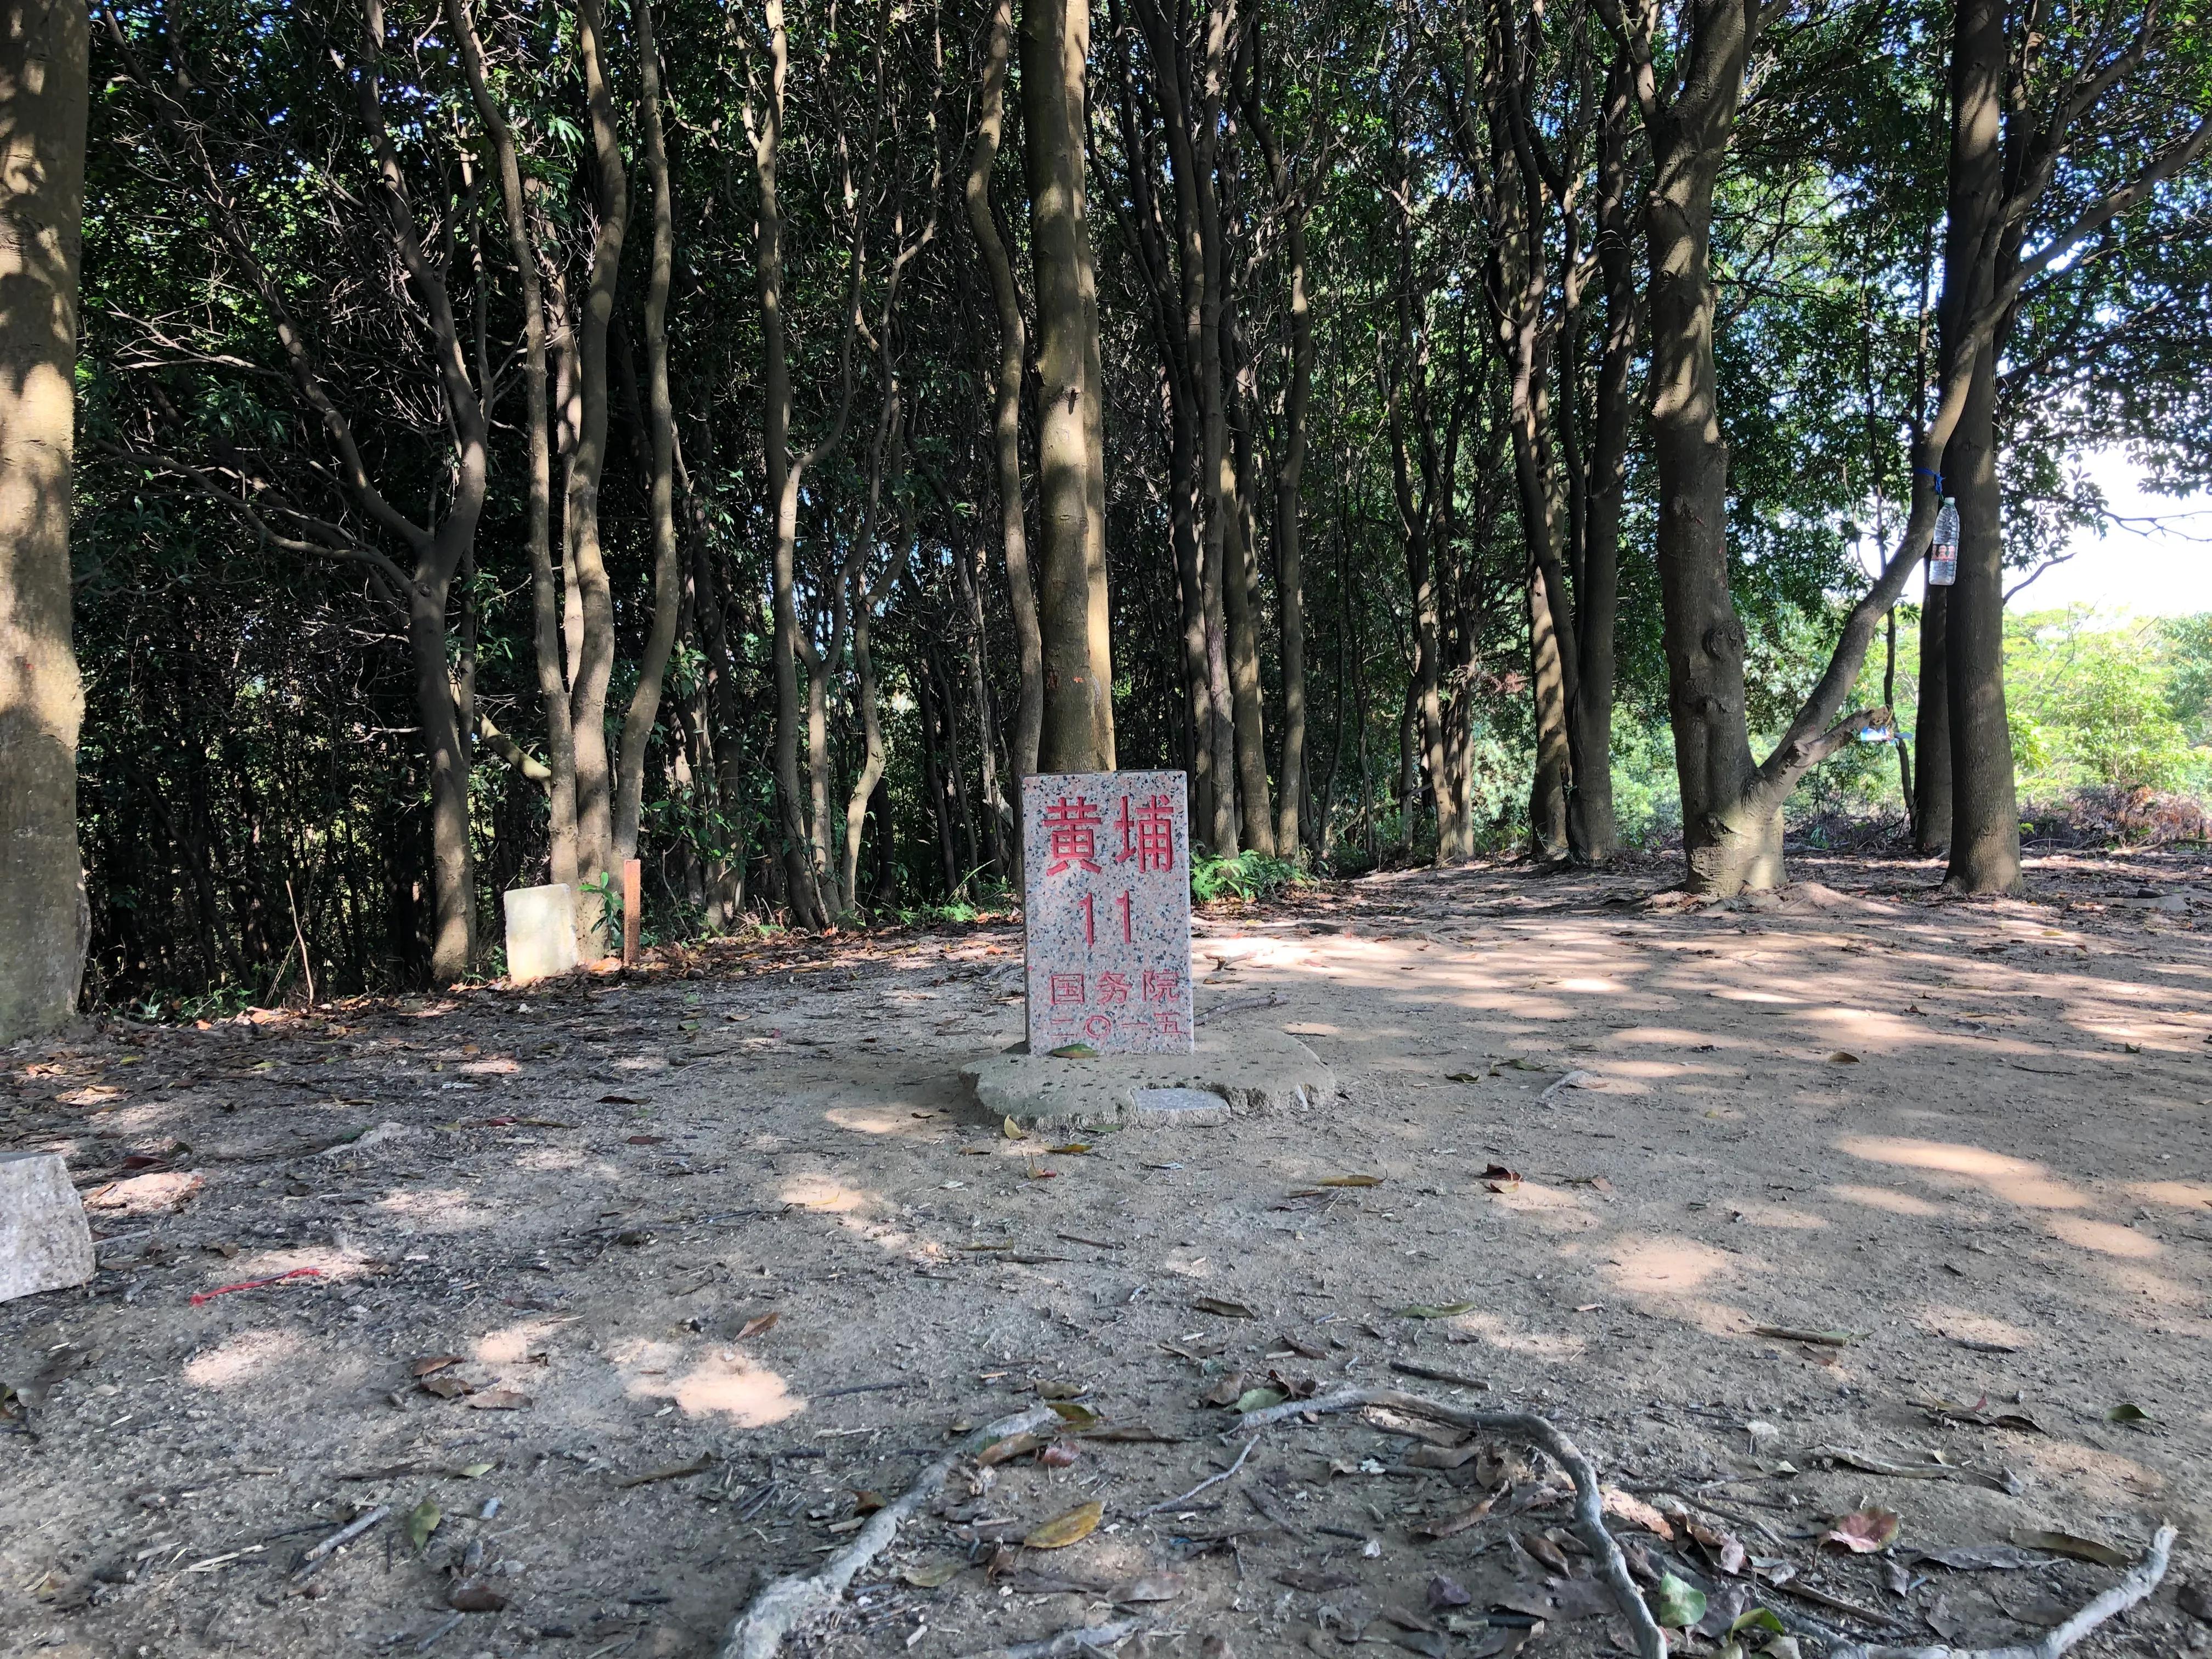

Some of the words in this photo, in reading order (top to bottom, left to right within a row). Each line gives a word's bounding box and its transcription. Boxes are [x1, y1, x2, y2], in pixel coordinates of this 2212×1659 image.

[1043, 795, 1174, 876] 黄埔
[1078, 890, 1131, 946] 11
[1050, 969, 1180, 1005] 国务院
